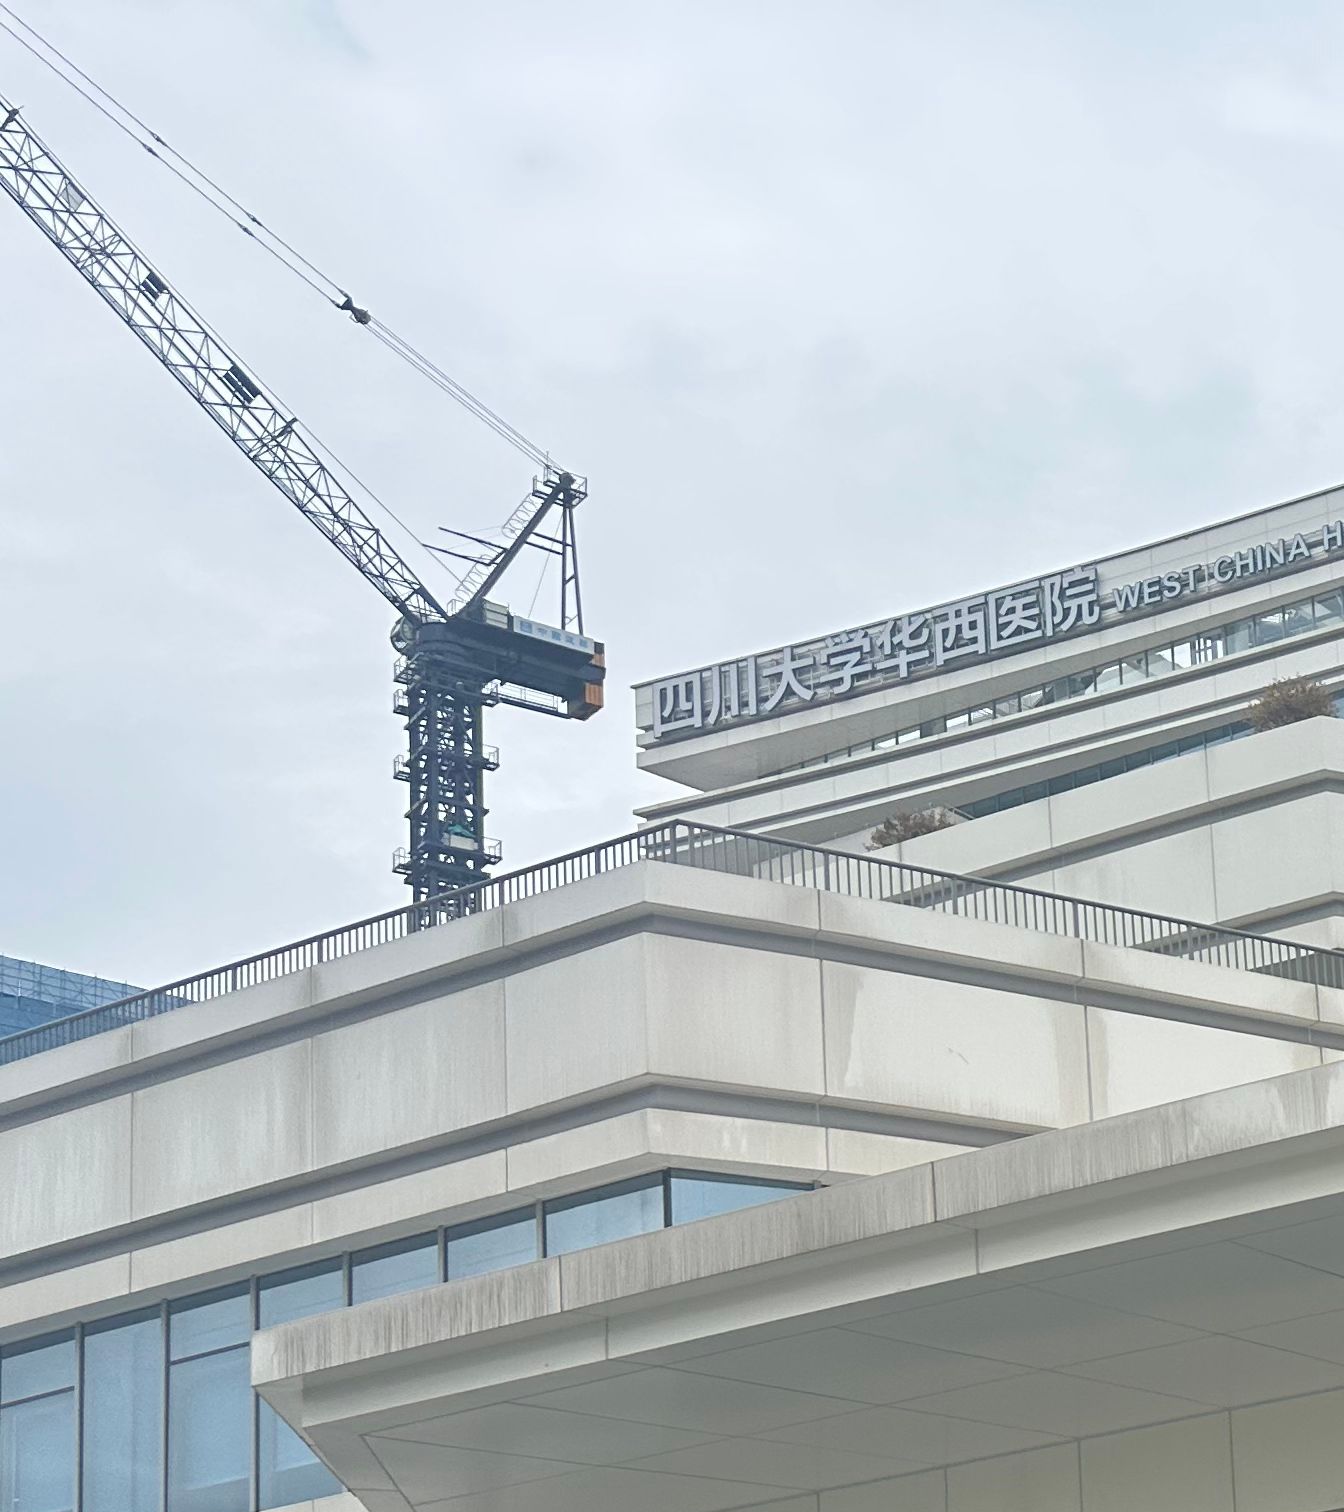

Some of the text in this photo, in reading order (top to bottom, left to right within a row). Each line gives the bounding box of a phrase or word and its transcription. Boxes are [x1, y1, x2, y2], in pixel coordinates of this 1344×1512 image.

[1112, 563, 1203, 613] WEST
[1211, 533, 1311, 583] CHINA
[652, 565, 1101, 739] 四川大学华西医院
